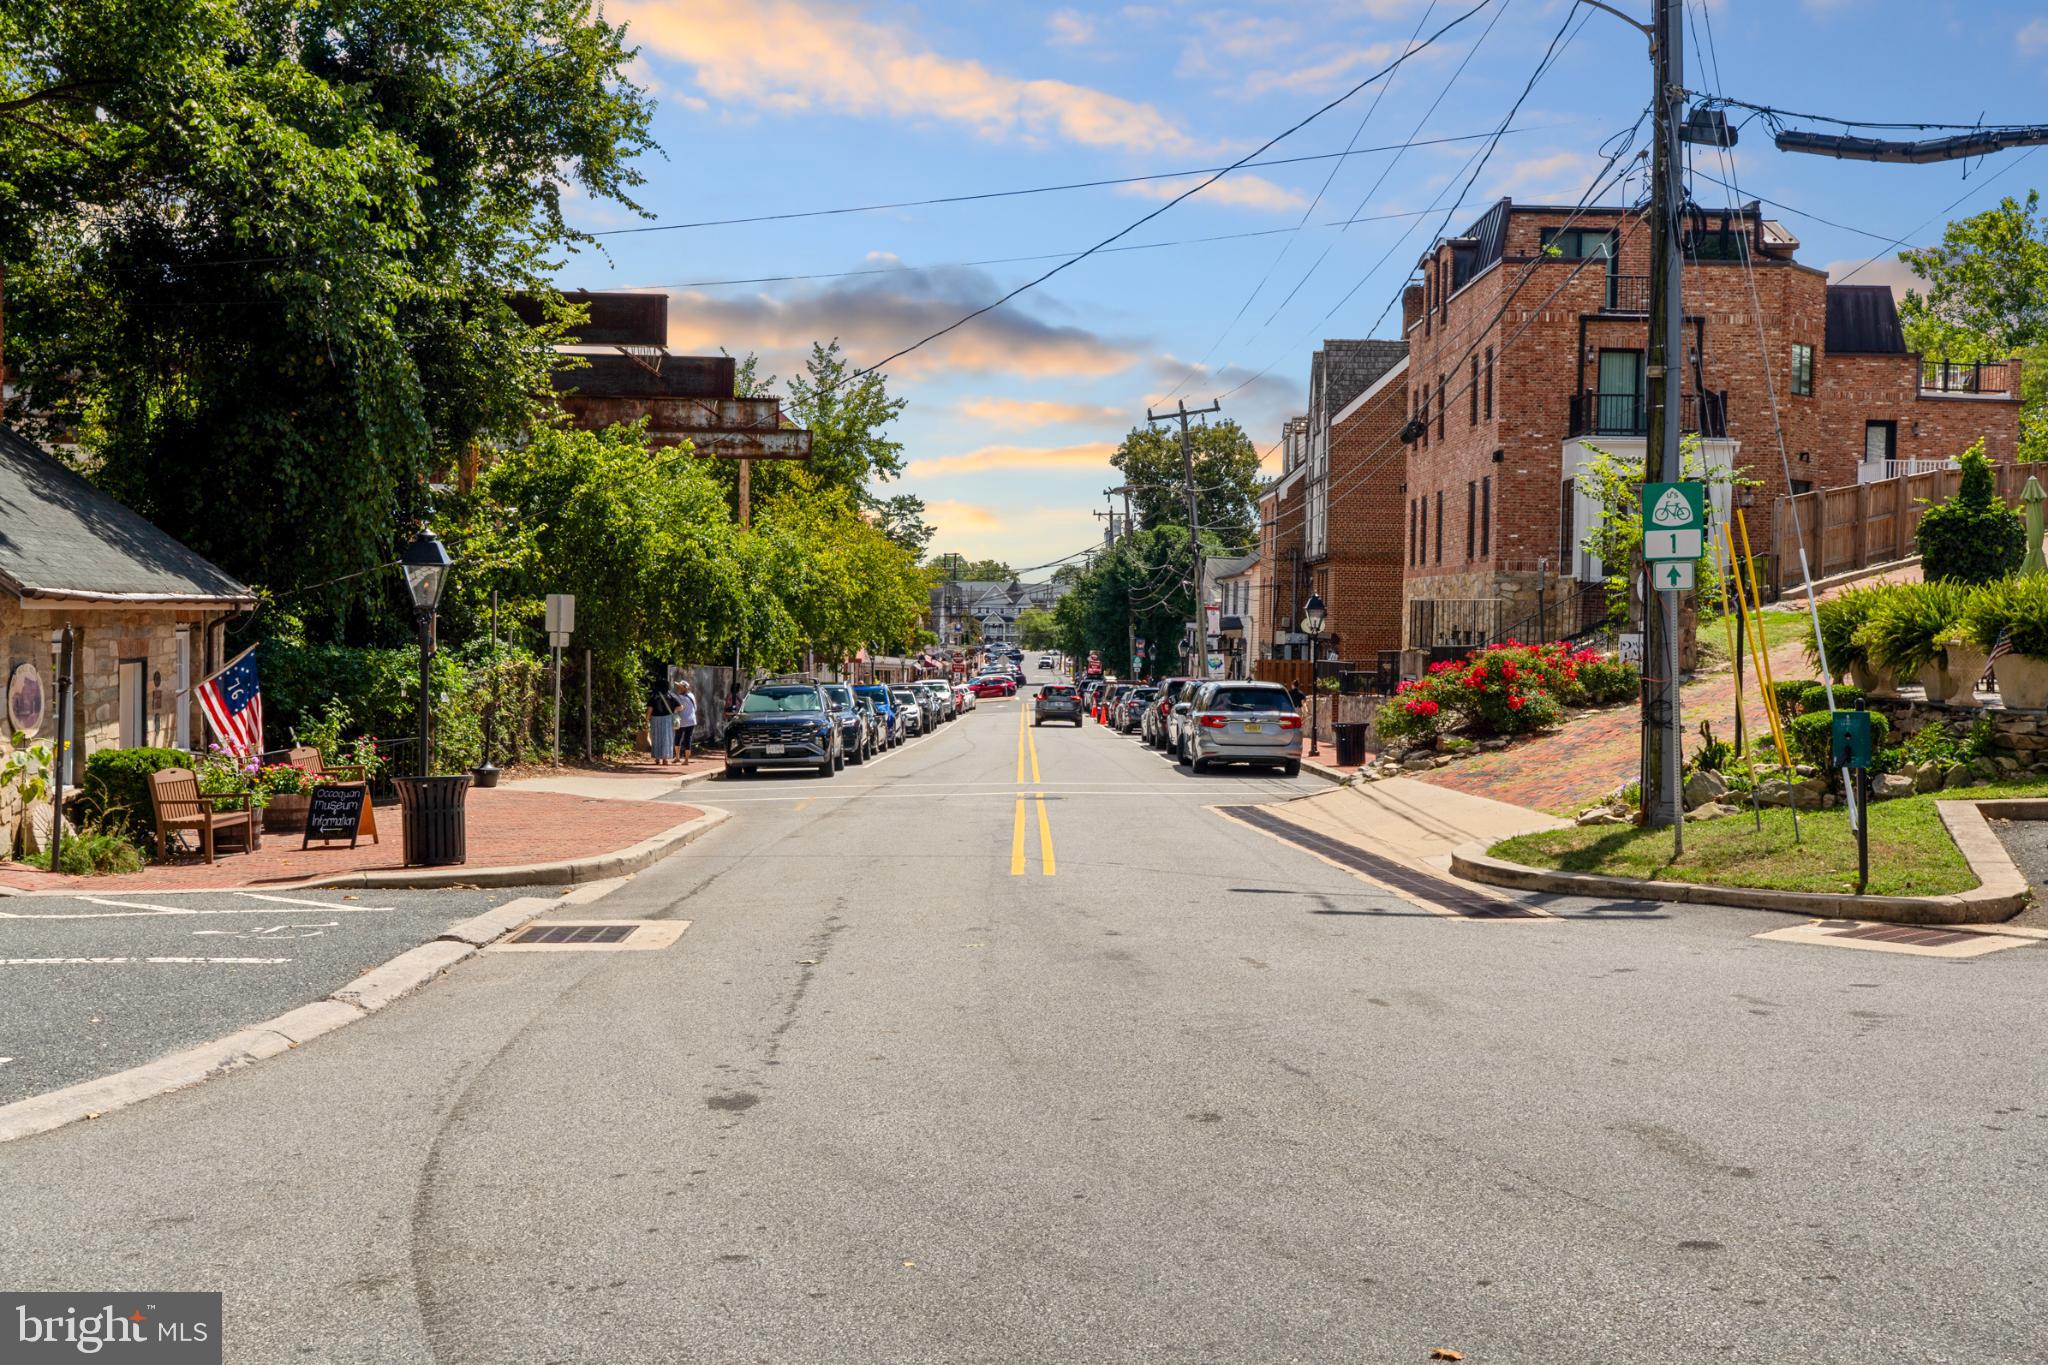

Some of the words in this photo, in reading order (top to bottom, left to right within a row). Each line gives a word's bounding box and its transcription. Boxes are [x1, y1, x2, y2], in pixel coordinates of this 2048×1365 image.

[1669, 533, 1677, 554] 1
[227, 677, 244, 700] 76
[317, 788, 361, 802] Occoquan
[314, 800, 359, 810] Museum
[311, 813, 356, 827] Information
